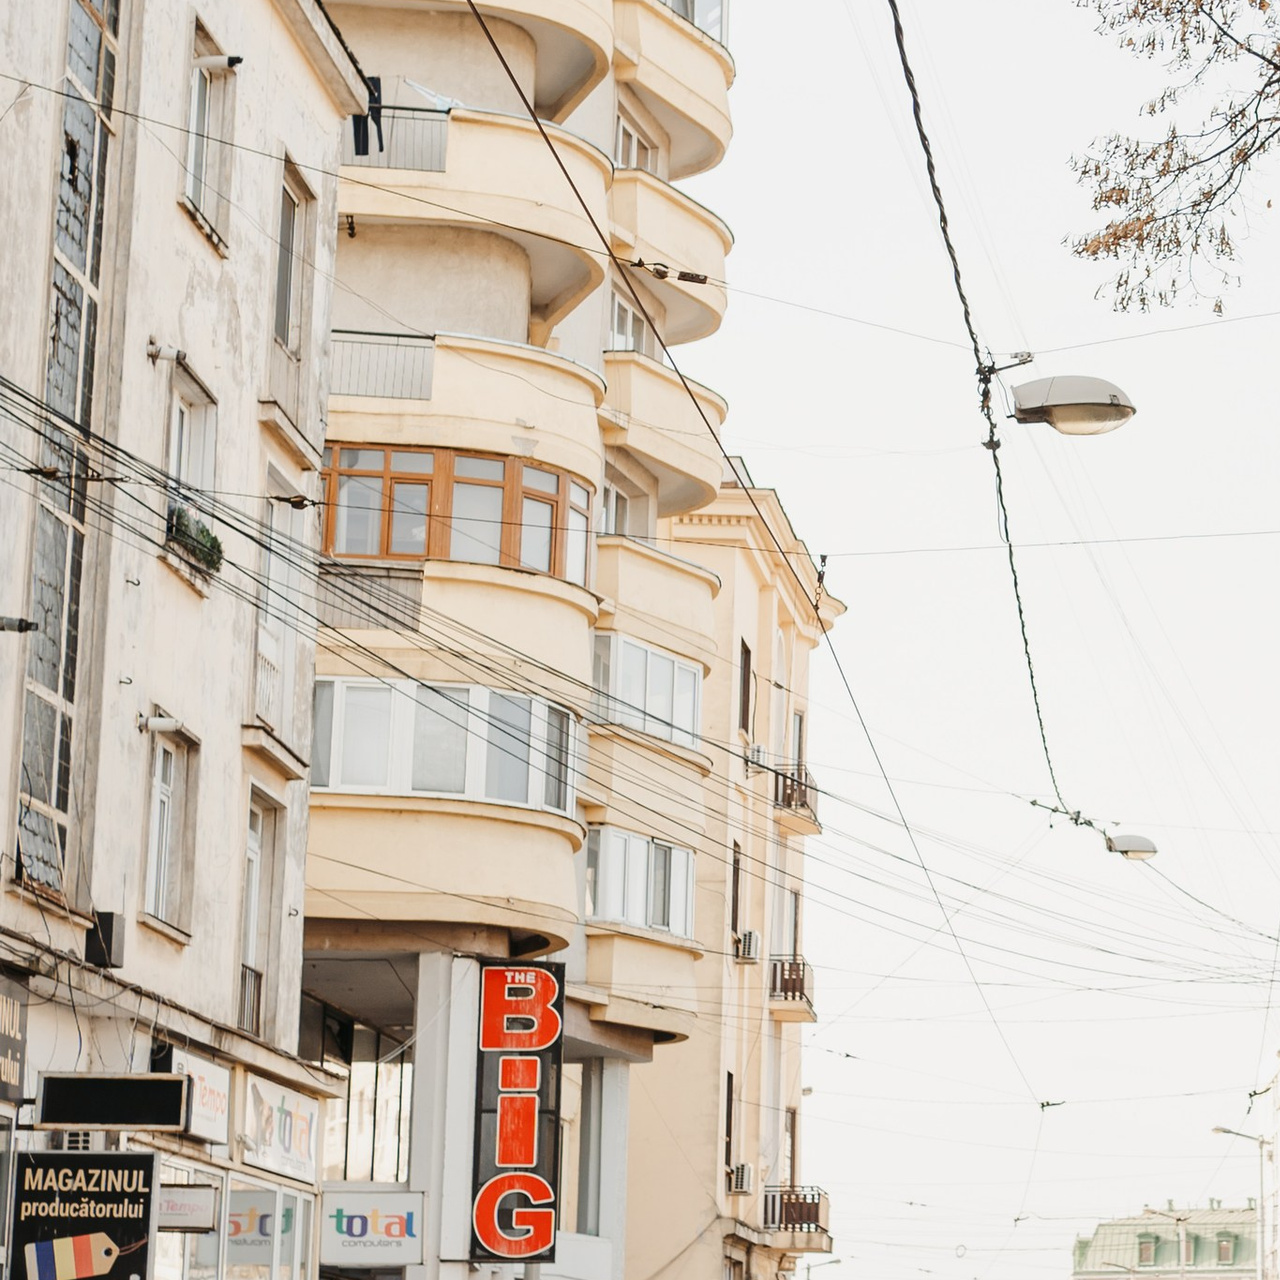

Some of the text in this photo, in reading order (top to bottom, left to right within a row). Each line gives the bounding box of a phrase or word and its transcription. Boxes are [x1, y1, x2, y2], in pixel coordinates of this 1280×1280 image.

[505, 971, 536, 983] THE
[24, 1168, 149, 1192] MAGAZINUL
[21, 1197, 144, 1221] producătorului
[329, 1208, 416, 1238] total
